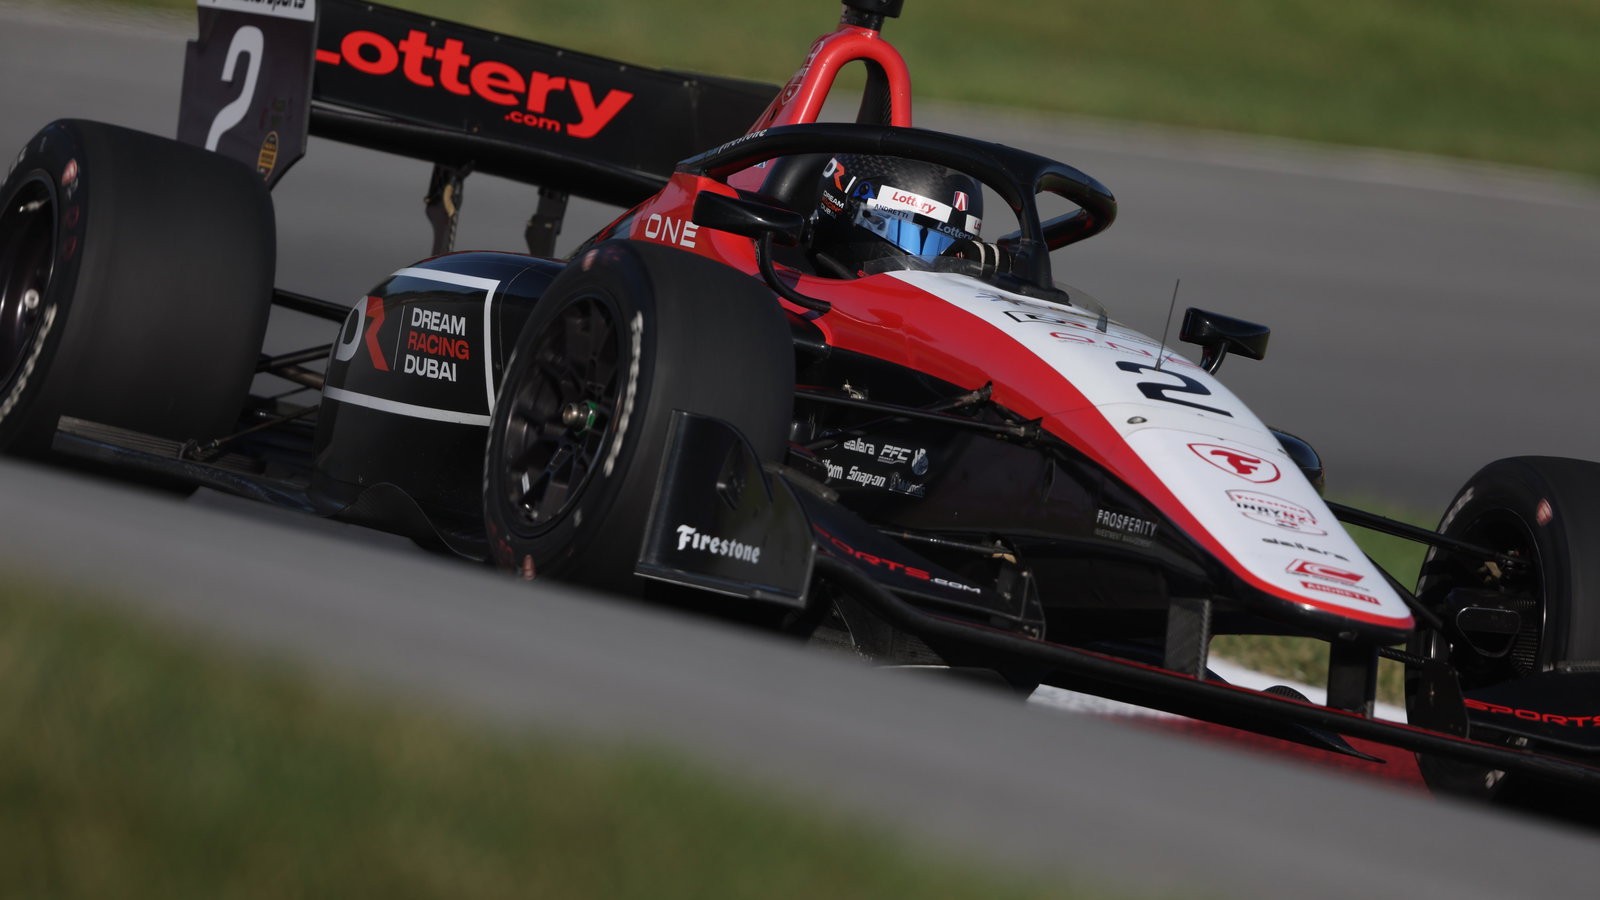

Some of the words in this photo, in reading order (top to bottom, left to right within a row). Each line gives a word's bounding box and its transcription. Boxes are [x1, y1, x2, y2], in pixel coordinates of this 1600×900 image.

[205, 25, 265, 152] 2
[504, 110, 561, 133] .com
[822, 189, 845, 210] DREAM
[874, 203, 909, 219] ANDRETTI
[891, 191, 937, 215] Lottry
[644, 213, 699, 249] ONE
[936, 222, 975, 241] Lottery
[411, 307, 466, 337] DREAM
[407, 331, 471, 361] RACING
[404, 354, 457, 383] DUBAI
[1115, 360, 1235, 419] 2
[879, 443, 912, 461] PFC
[847, 465, 887, 488] Snap-on
[1096, 508, 1158, 537] PROSPERITY
[675, 523, 761, 564] Firestone
